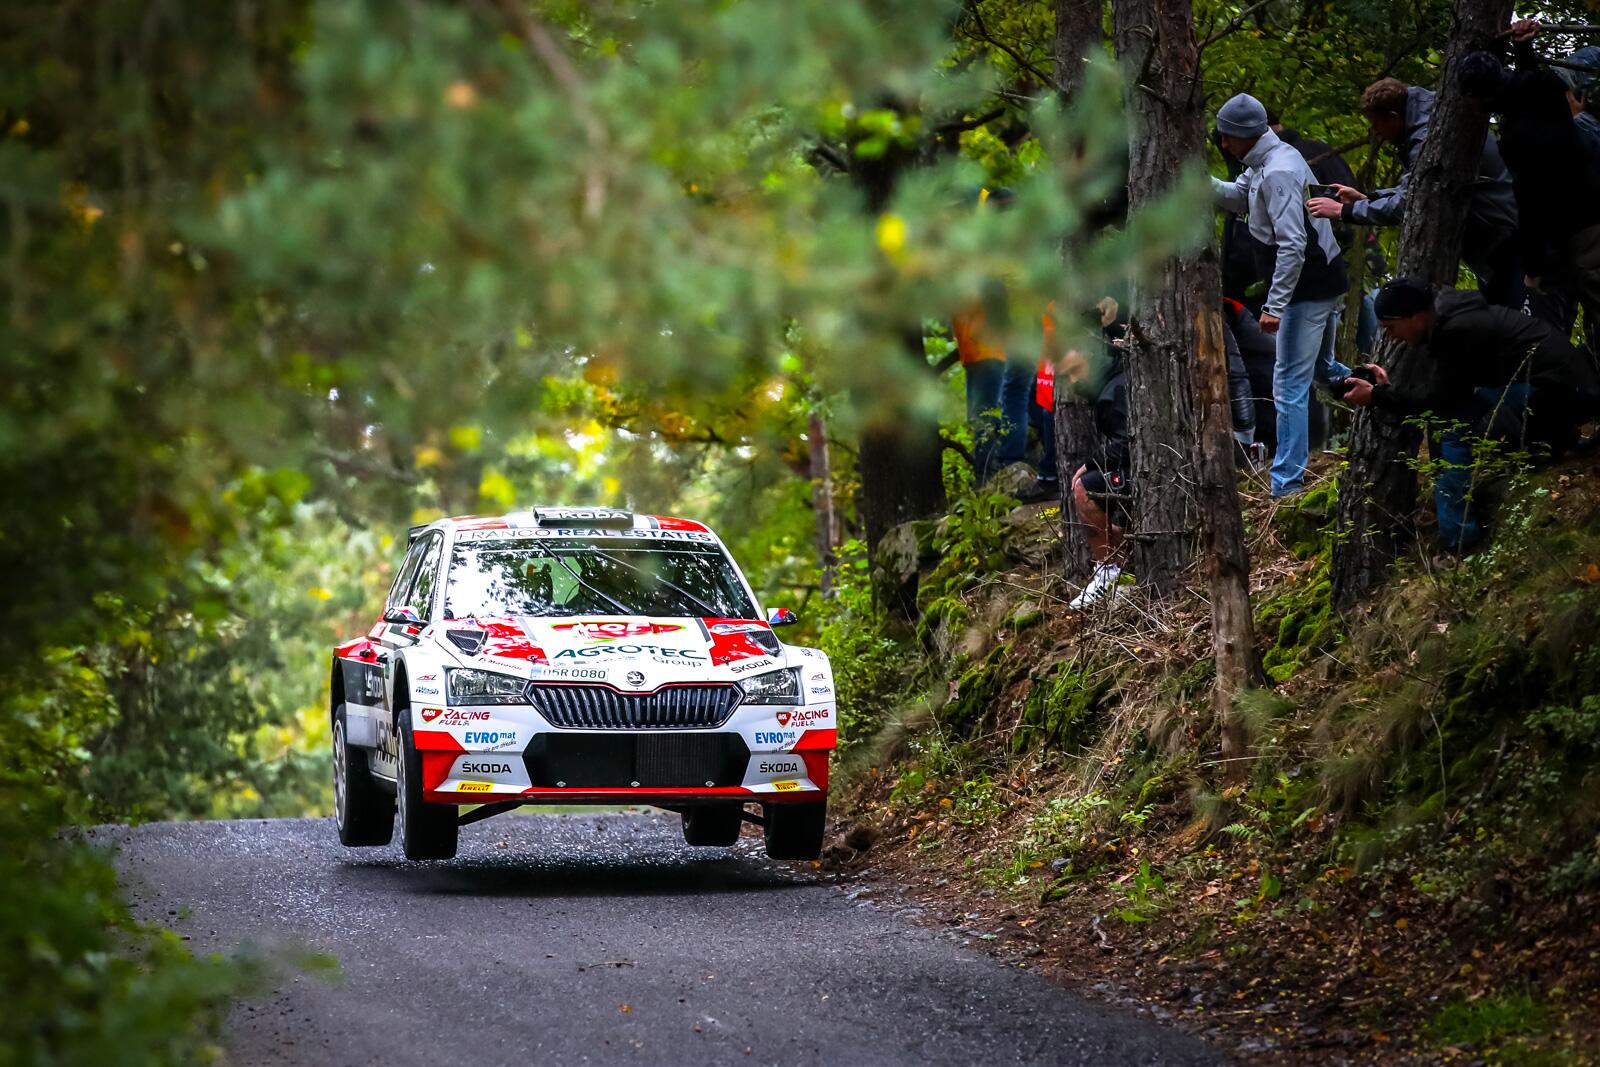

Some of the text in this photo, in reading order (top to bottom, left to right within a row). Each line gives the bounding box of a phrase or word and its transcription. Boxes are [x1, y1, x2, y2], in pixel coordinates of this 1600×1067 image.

[459, 529, 712, 541] FRANCO REAL ESTATES
[553, 645, 707, 660] AGROTEC
[652, 656, 702, 668] Group
[571, 668, 606, 679] 0080
[423, 709, 437, 717] MOL
[444, 708, 491, 720] RACING
[792, 709, 829, 721] RACING
[462, 761, 512, 773] ŠKODA
[760, 762, 798, 773] ŠKODA
